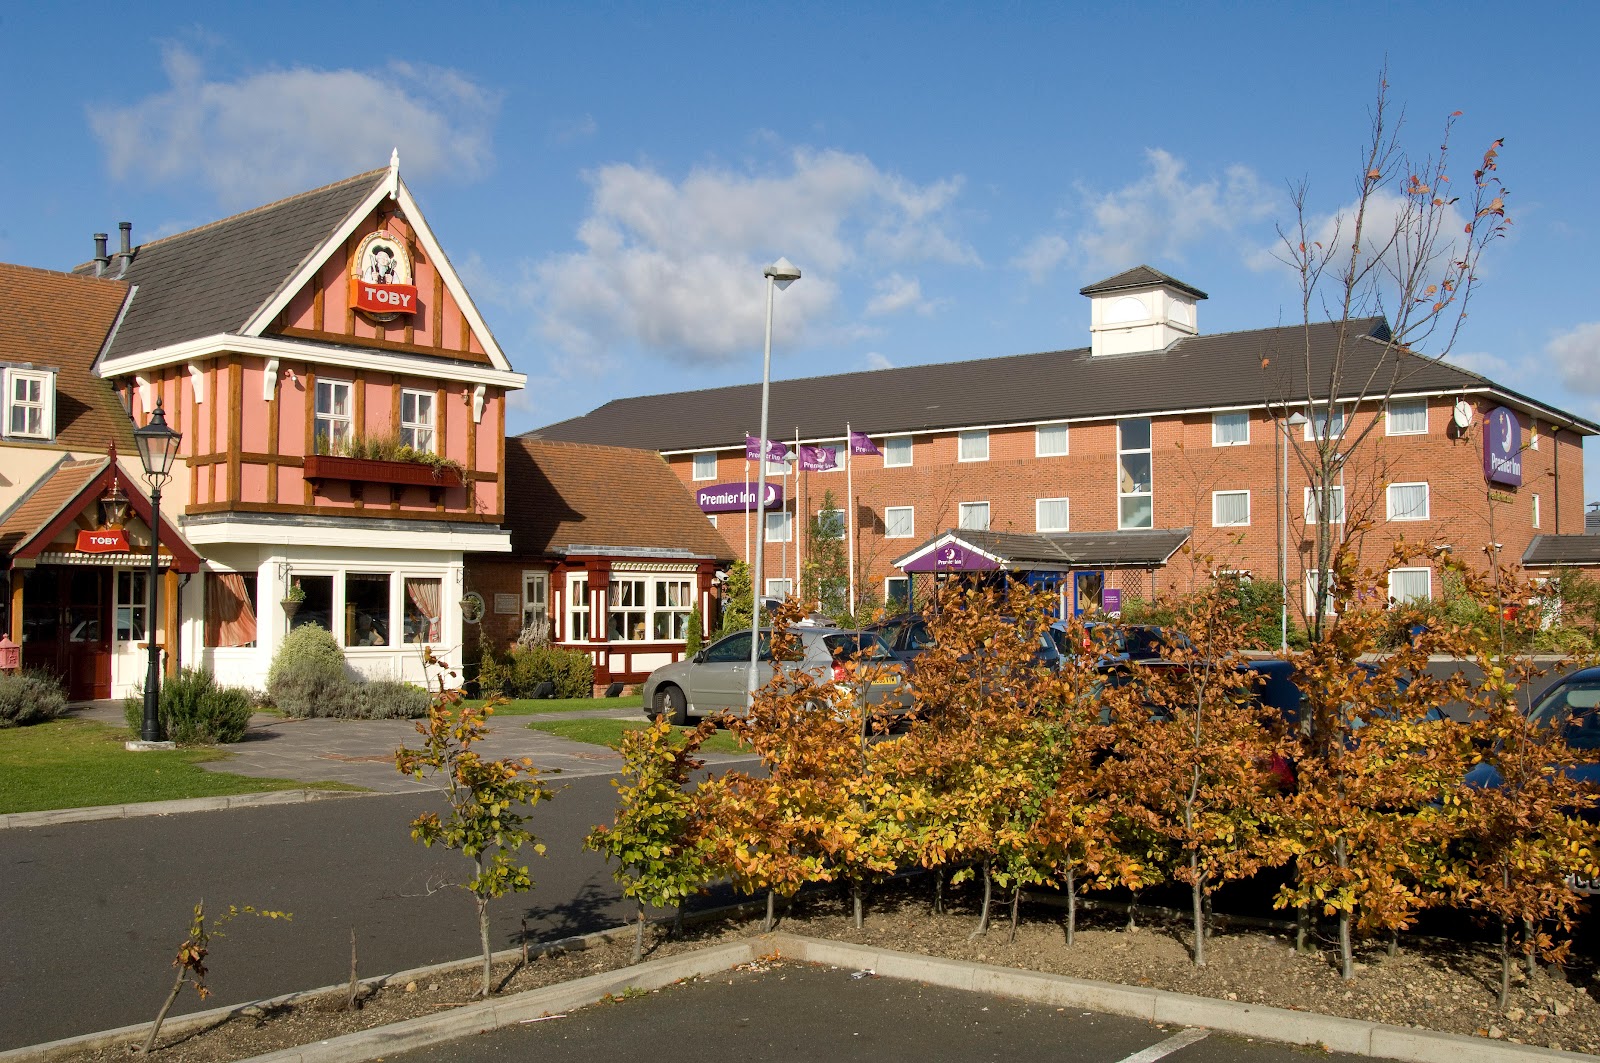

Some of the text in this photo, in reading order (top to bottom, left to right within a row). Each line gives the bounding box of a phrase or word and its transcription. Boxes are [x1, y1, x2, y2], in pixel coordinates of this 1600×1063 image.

[365, 287, 411, 307] TOBY
[1491, 453, 1520, 475] Premier Inn
[700, 491, 756, 505] Premier Inn
[90, 537, 118, 545] TOBY
